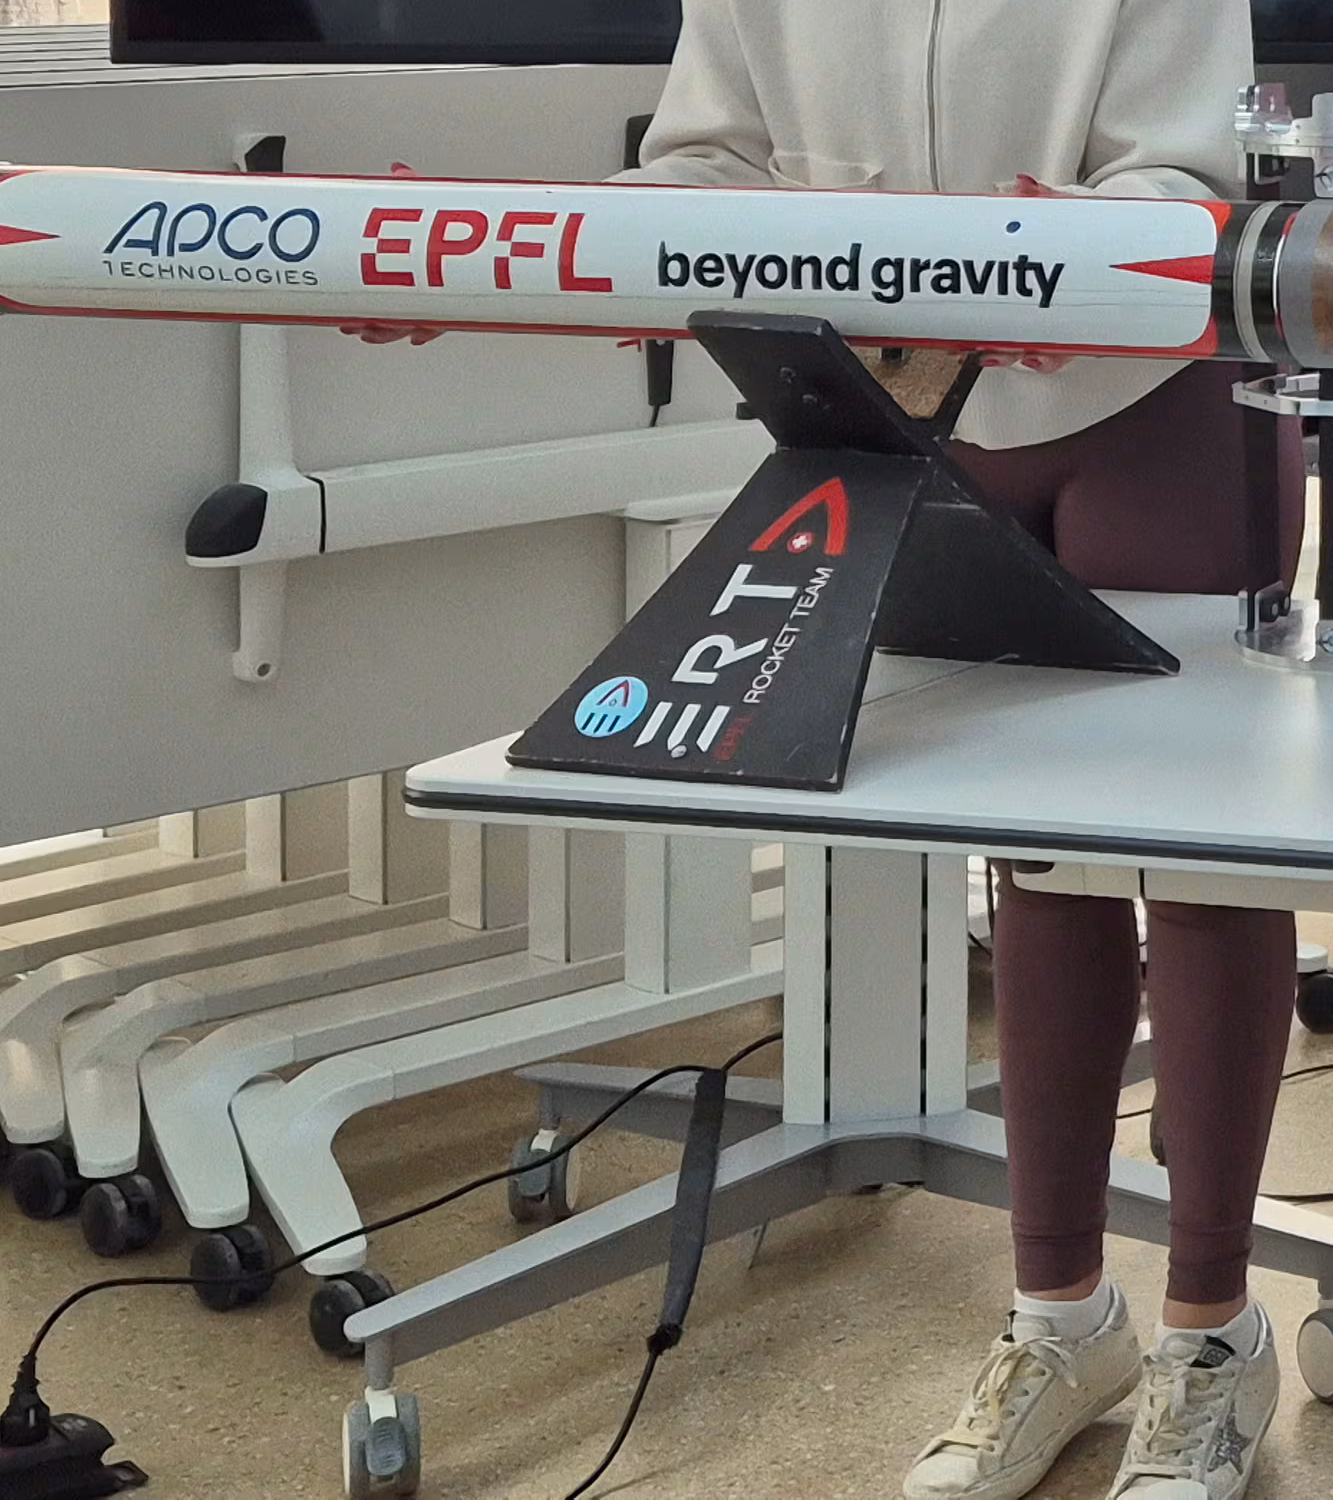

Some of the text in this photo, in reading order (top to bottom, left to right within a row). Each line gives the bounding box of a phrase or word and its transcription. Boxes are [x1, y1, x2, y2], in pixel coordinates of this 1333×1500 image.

[103, 201, 321, 262] APCO
[361, 208, 613, 293] EPFL
[103, 260, 318, 286] TECHNOLOGIES
[658, 241, 1065, 308] beyond gravity
[633, 563, 799, 753] ERT
[743, 566, 835, 704] ROCKET TEAM
